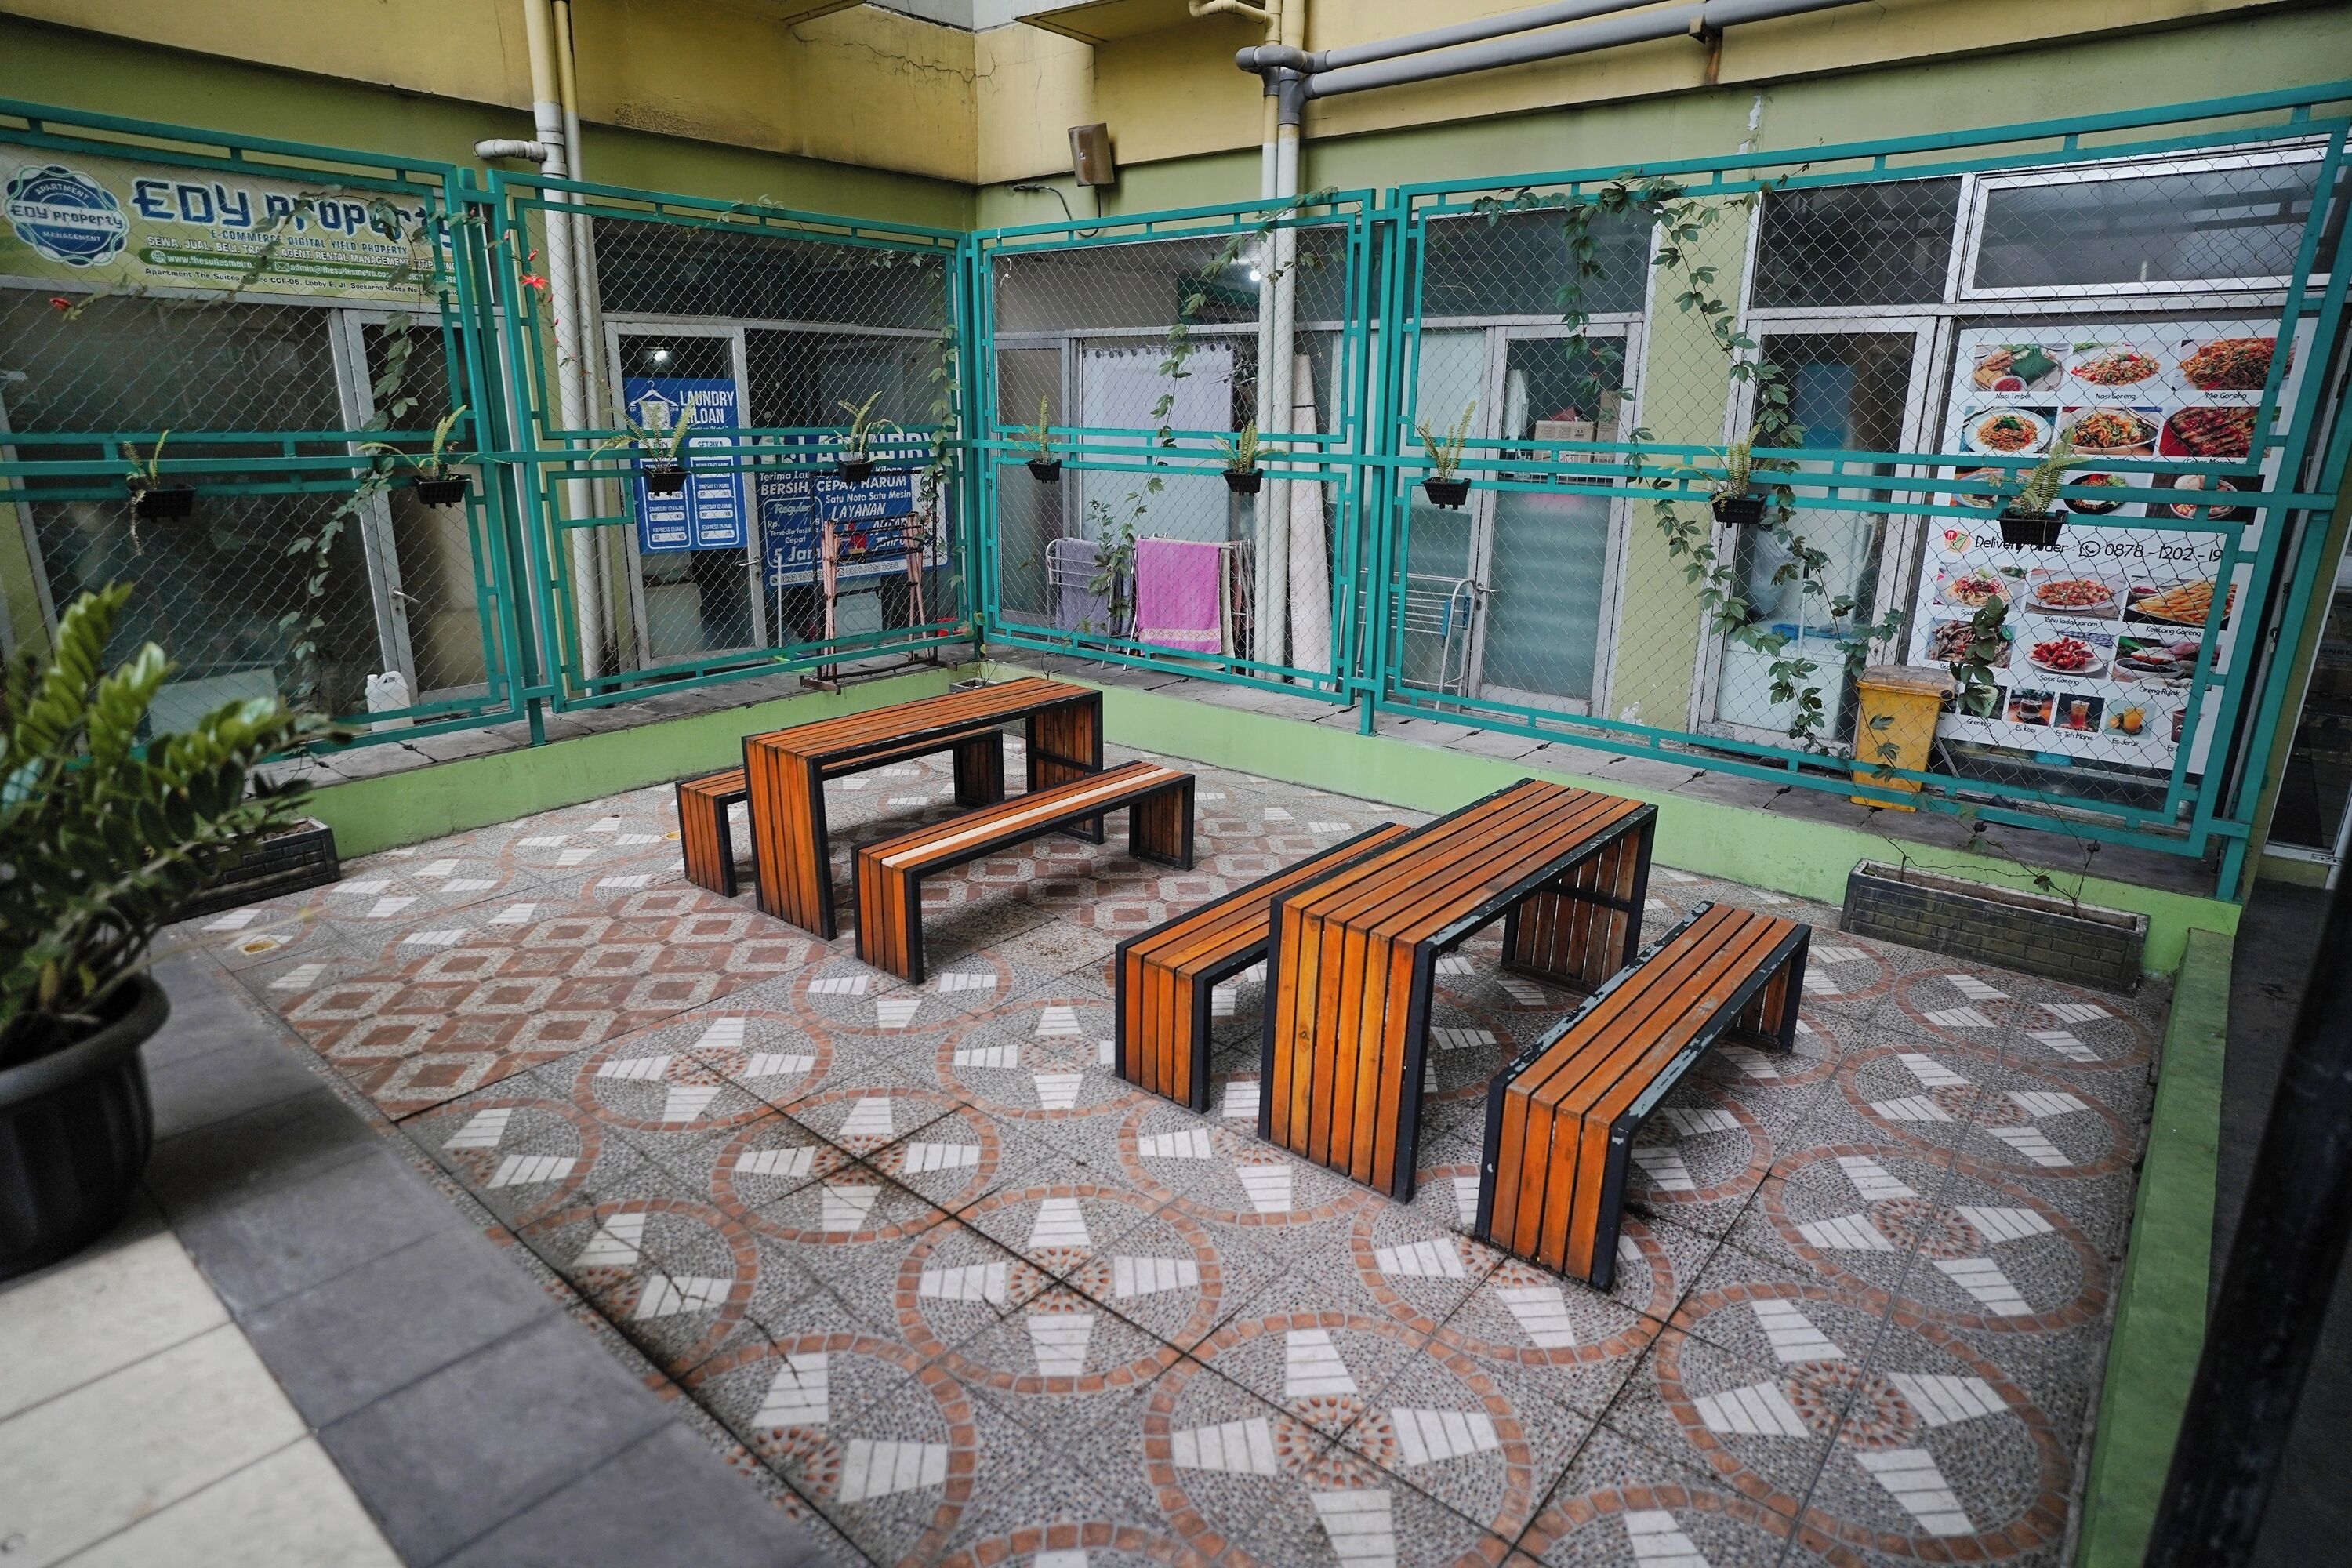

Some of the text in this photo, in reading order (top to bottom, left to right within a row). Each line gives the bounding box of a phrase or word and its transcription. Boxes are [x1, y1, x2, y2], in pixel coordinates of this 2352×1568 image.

[34, 183, 90, 200] APARTMENT
[132, 180, 252, 228] EDY
[11, 204, 49, 220] EDY
[42, 230, 102, 242] MANAGEMENT
[147, 236, 183, 249] SEWA.
[184, 240, 213, 252] JUAL.
[242, 245, 279, 257] TRAL
[281, 248, 314, 260] AGENT.
[315, 250, 349, 263] RENTAL
[288, 236, 326, 249] DIGITAL
[330, 241, 356, 251] YIELD
[361, 243, 408, 255] PROPERTY
[145, 268, 193, 281] Apartment
[194, 271, 211, 280] The
[213, 273, 241, 282] Suites
[305, 279, 326, 289] Lobby
[350, 282, 383, 292] Soekarno
[679, 390, 735, 408] LAUNDRY
[2111, 393, 2136, 401] Goreng
[2220, 391, 2247, 401] Goreng
[760, 471, 791, 481] Terima
[760, 481, 811, 496] BERSIH,
[860, 474, 906, 489] HARUM
[825, 493, 844, 504] Satu
[847, 492, 866, 503] Nota
[869, 491, 887, 502] Satu
[888, 489, 911, 499] Mesin
[831, 502, 887, 523] LAYANAN
[785, 535, 807, 545] Cepat
[2104, 543, 2144, 557] 0878
[2158, 545, 2194, 561] 1202
[2145, 626, 2201, 638] Kentang Goreng
[2056, 676, 2080, 685] Goreng
[2023, 725, 2037, 734] Kopi
[2075, 732, 2094, 742] Manis
